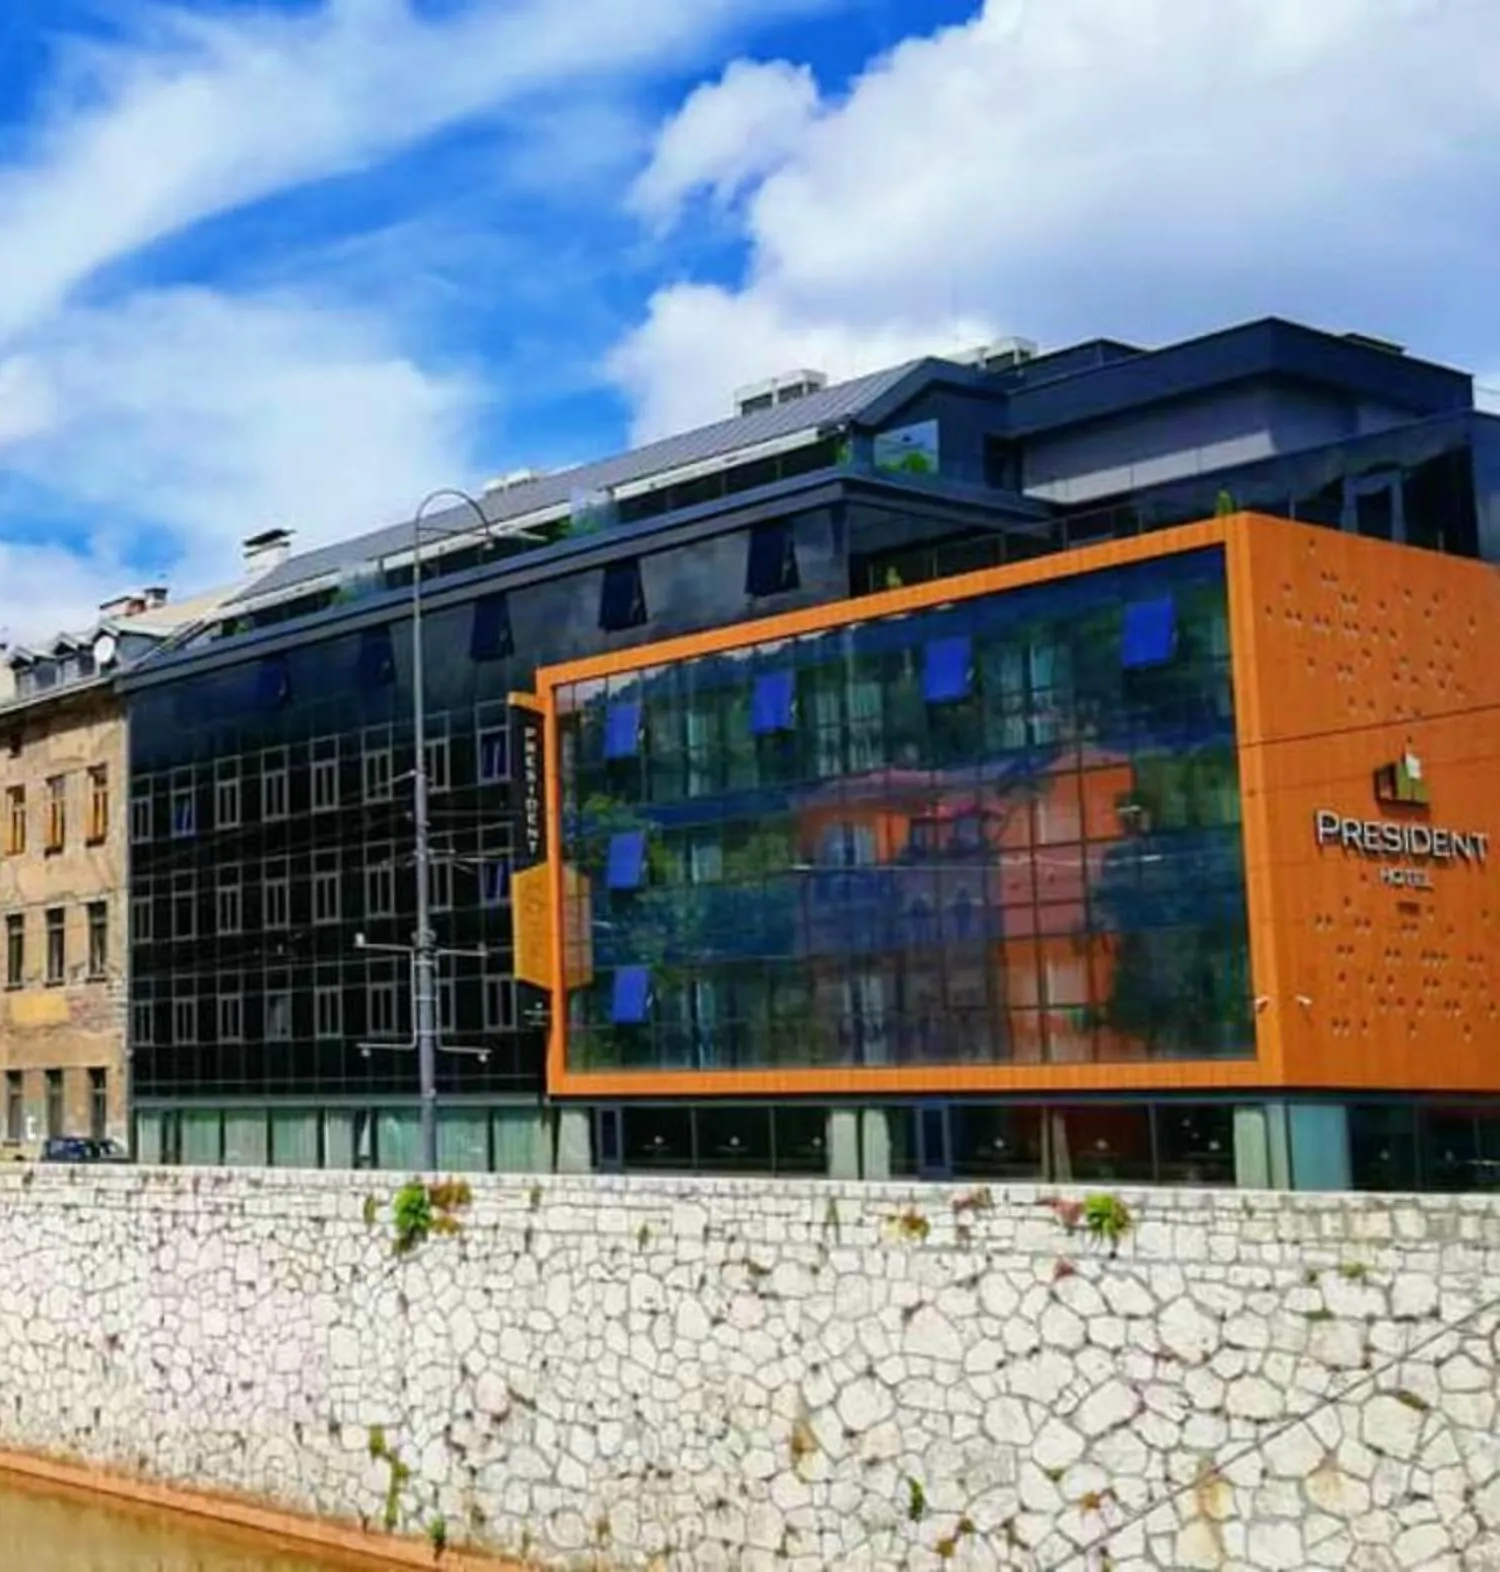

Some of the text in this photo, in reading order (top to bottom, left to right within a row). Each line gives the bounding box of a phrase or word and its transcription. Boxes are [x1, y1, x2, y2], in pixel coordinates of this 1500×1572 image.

[525, 727, 539, 854] PRESIDENT
[1316, 809, 1489, 859] PRESIDENT
[1380, 866, 1433, 887] HOTEL
